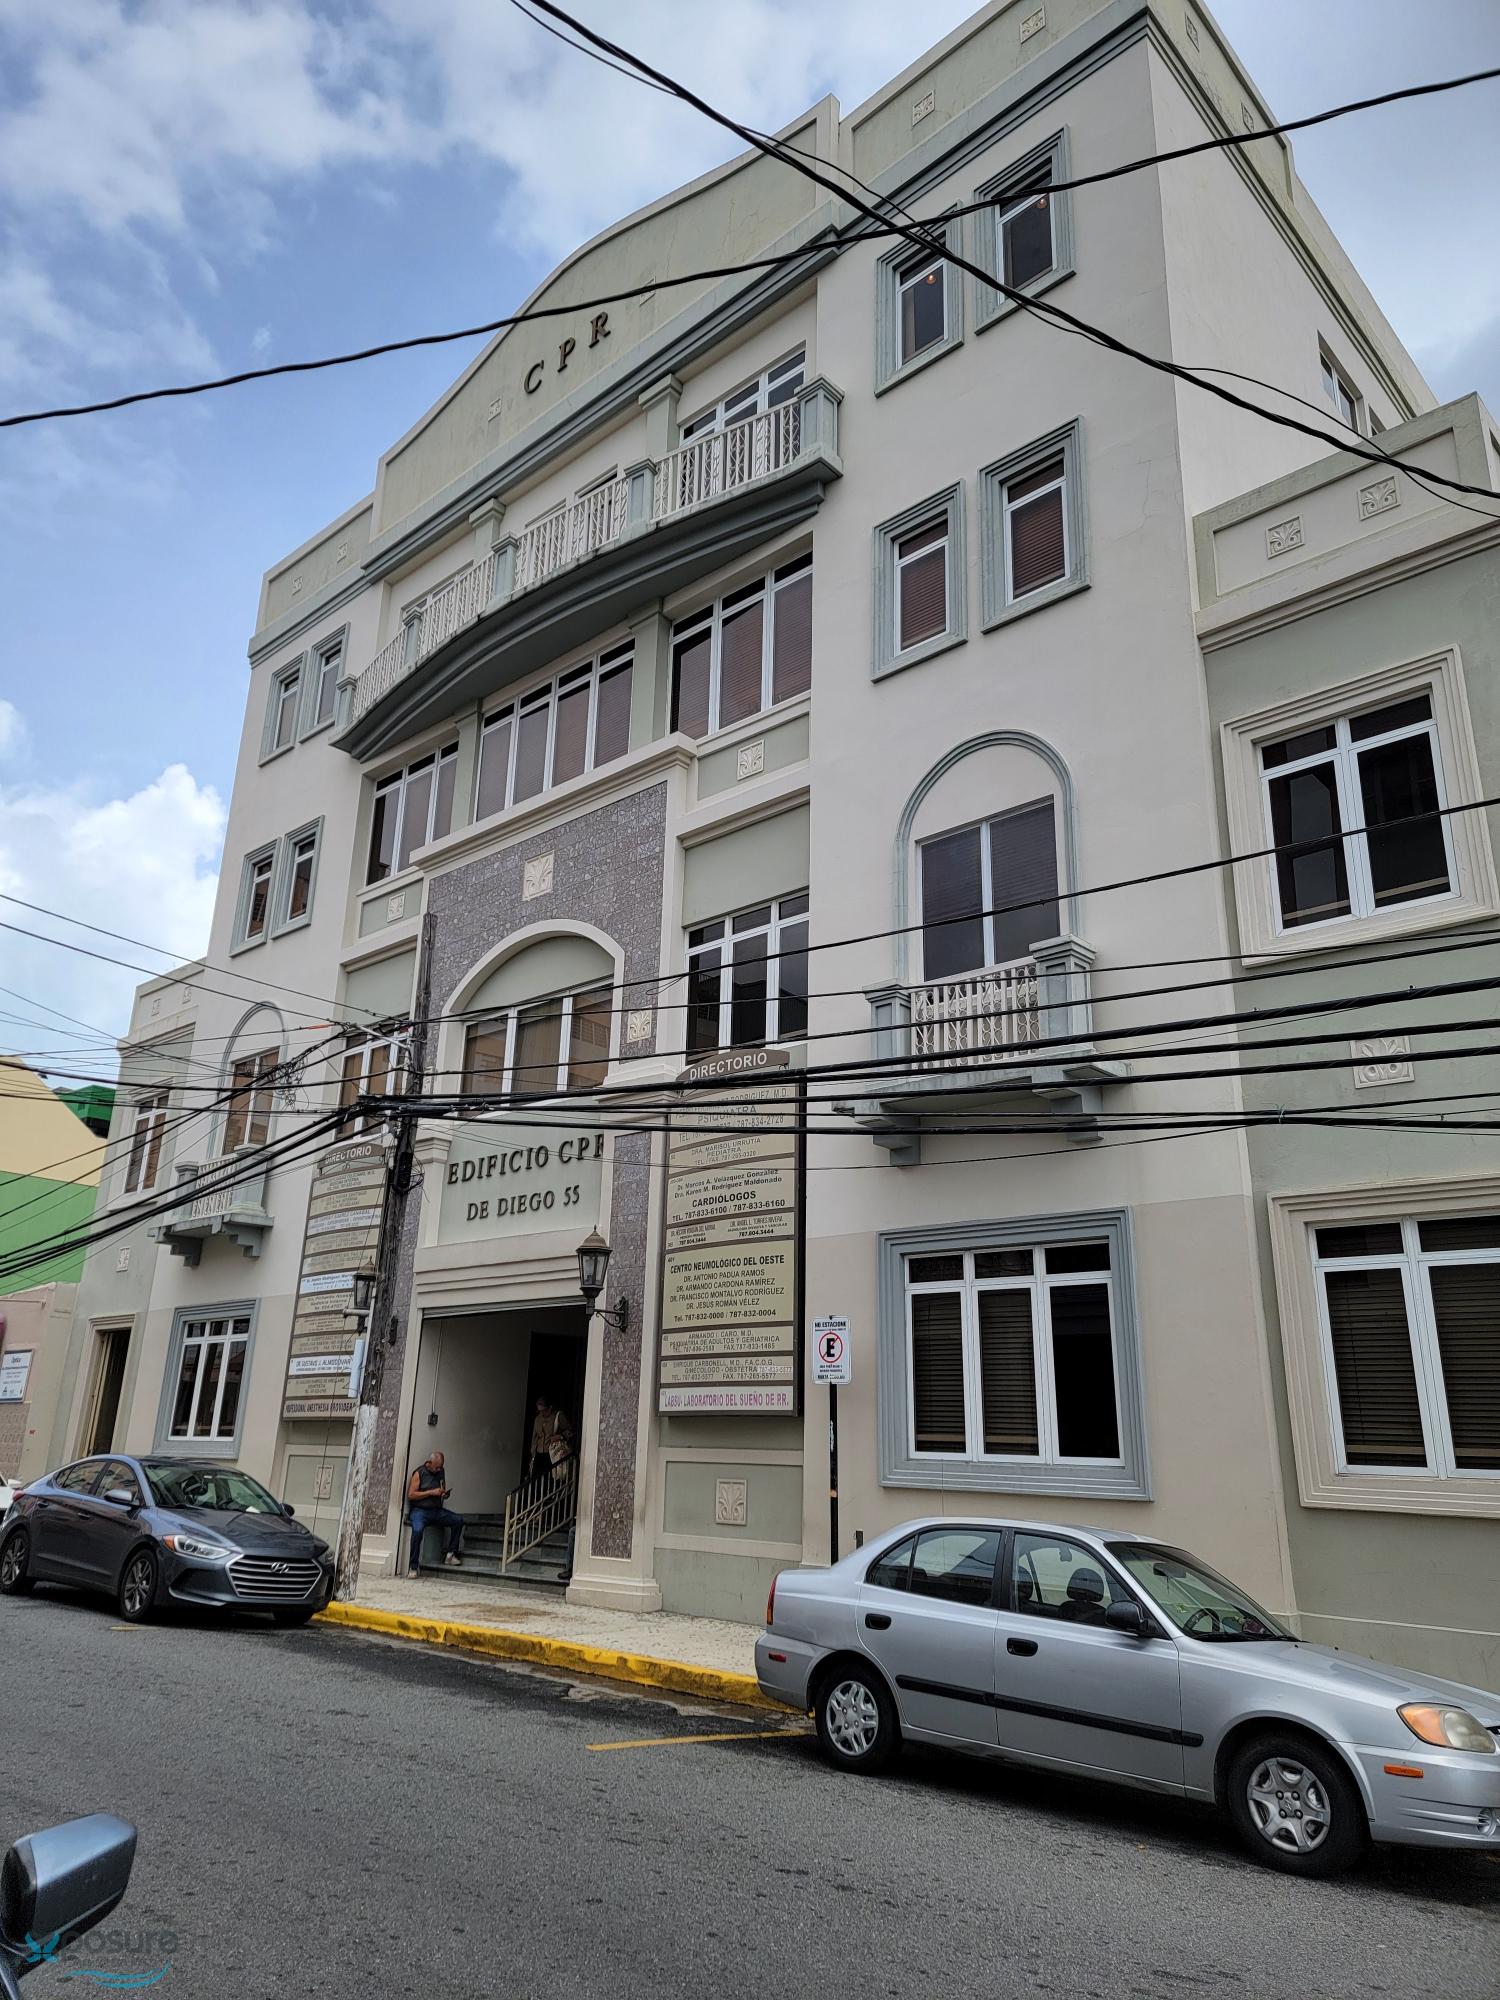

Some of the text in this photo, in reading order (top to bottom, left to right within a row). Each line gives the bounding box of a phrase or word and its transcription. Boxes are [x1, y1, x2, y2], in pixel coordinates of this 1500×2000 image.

[689, 1051, 768, 1081] DIRECTORIO
[324, 1145, 372, 1164] DIRECTORIO
[447, 1145, 549, 1185] EDIFICIO
[743, 1177, 782, 1186] Maldonado
[466, 1184, 580, 1221] DE DIEGO 55
[692, 1190, 757, 1208] CARDIÓLOGOS
[670, 1263, 692, 1274] CENTRO
[743, 1256, 758, 1266] DEL
[759, 1254, 785, 1265] OESTE
[683, 1275, 693, 1283] DR.
[693, 1272, 718, 1282] ANTONIO
[740, 1268, 765, 1277] RAMOS
[685, 1281, 713, 1292] ARMANDO
[713, 1279, 744, 1289] CARDONA
[678, 1291, 709, 1302] FRANCISCO
[709, 1289, 743, 1299] MONTALVO
[744, 1286, 785, 1296] RODRÍGUEZ
[695, 1299, 714, 1309] JESÚS
[739, 1296, 760, 1306] VÉLEZ
[822, 1320, 847, 1328] ESTACIONE
[688, 1331, 713, 1340] ARMANDO
[740, 1329, 754, 1337] M.D.
[708, 1337, 735, 1346] ADULTOS
[741, 1335, 780, 1344] GERIATRICA
[826, 1337, 835, 1358] E
[724, 1366, 758, 1374] OBSTETRA
[683, 1393, 724, 1408] LABORATORIO
[724, 1393, 738, 1407] DEL
[739, 1390, 763, 1407] SUEÑO
[765, 1392, 775, 1406] DE
